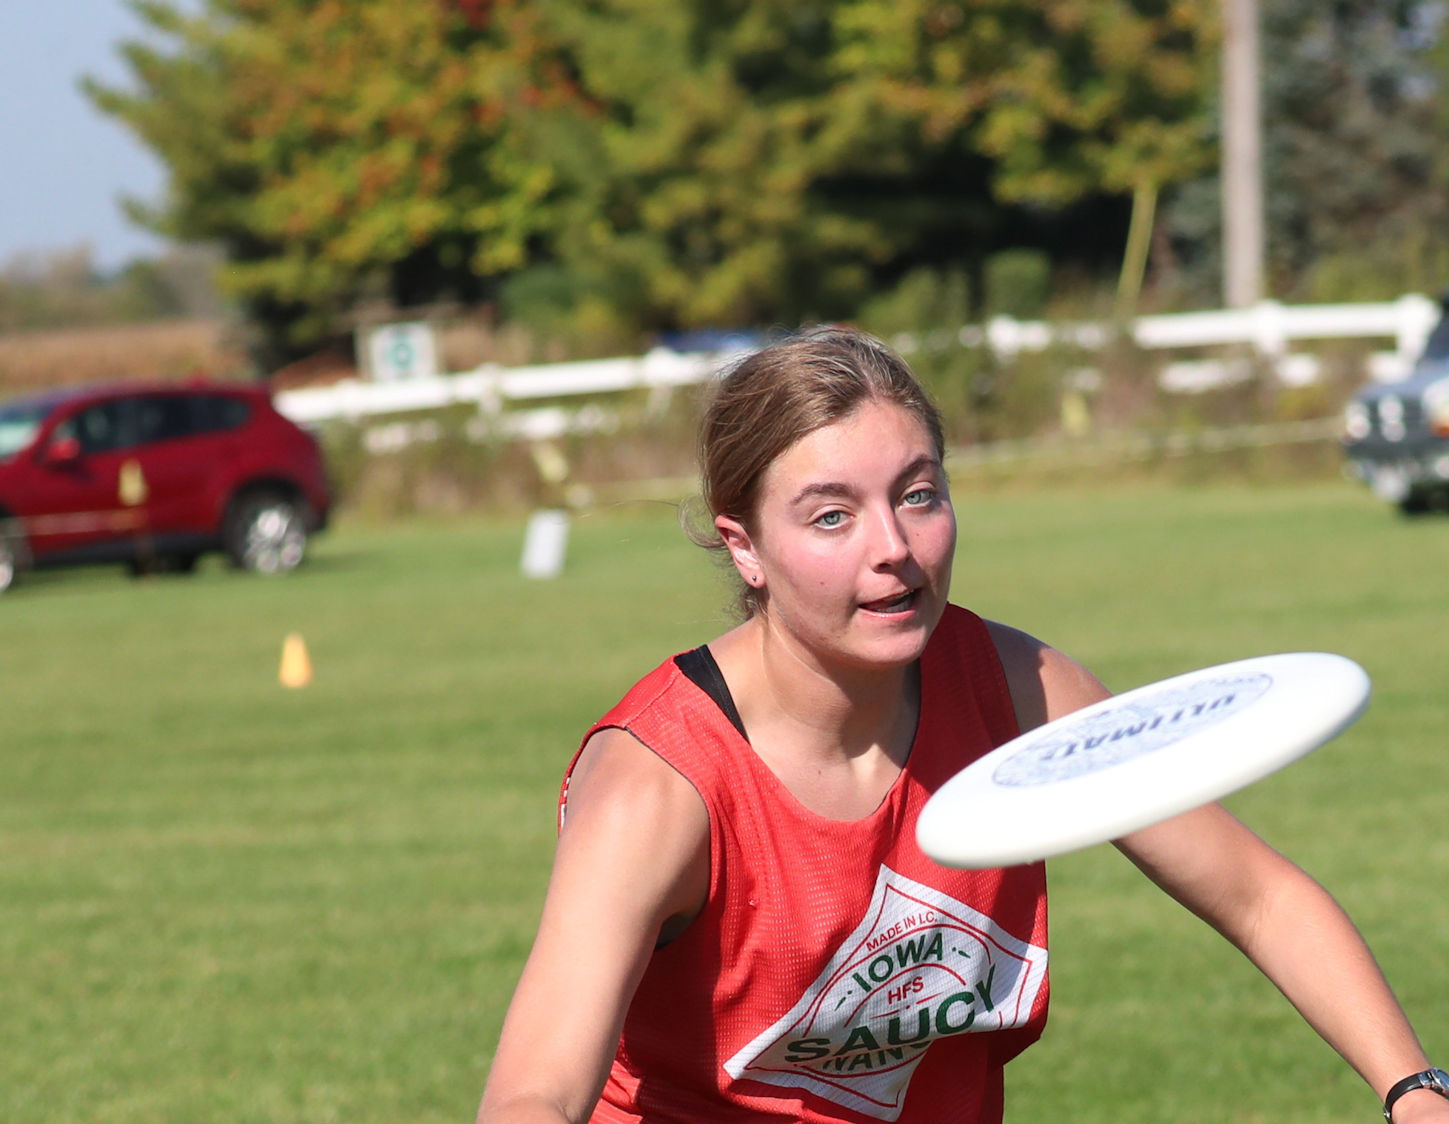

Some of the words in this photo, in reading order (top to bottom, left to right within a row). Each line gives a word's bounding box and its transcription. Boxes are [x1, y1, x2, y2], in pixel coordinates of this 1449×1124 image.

[866, 922, 903, 951] MADE
[903, 915, 917, 929] IN
[852, 933, 943, 992] IOWA
[785, 964, 996, 1063] SAUCY
[888, 976, 924, 1004] HFS
